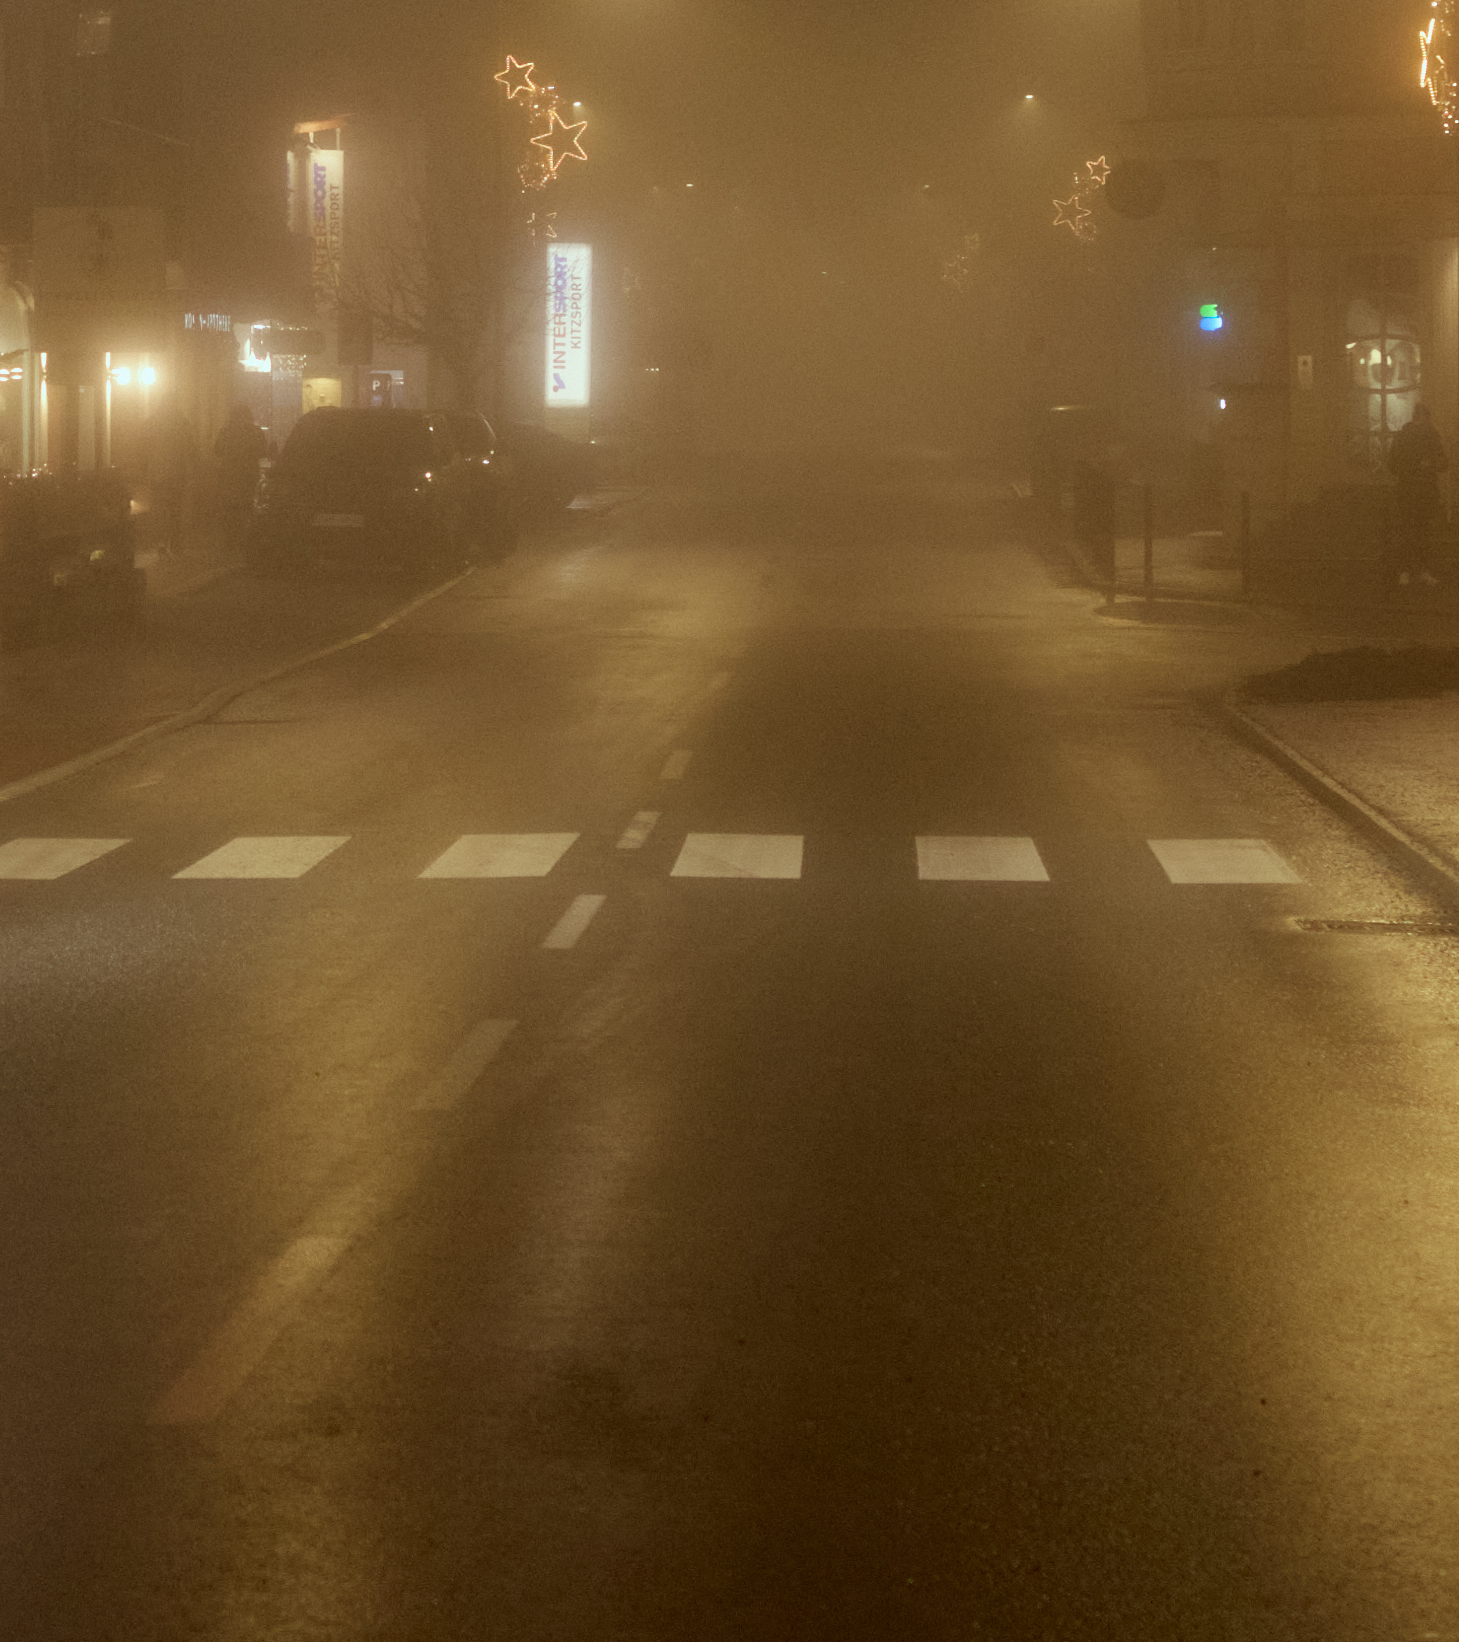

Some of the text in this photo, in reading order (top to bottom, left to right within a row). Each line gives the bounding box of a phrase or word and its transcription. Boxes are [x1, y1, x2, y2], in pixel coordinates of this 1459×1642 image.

[553, 253, 568, 370] INTERSPORT
[570, 274, 582, 349] KITZSPORT
[372, 380, 381, 391] P
